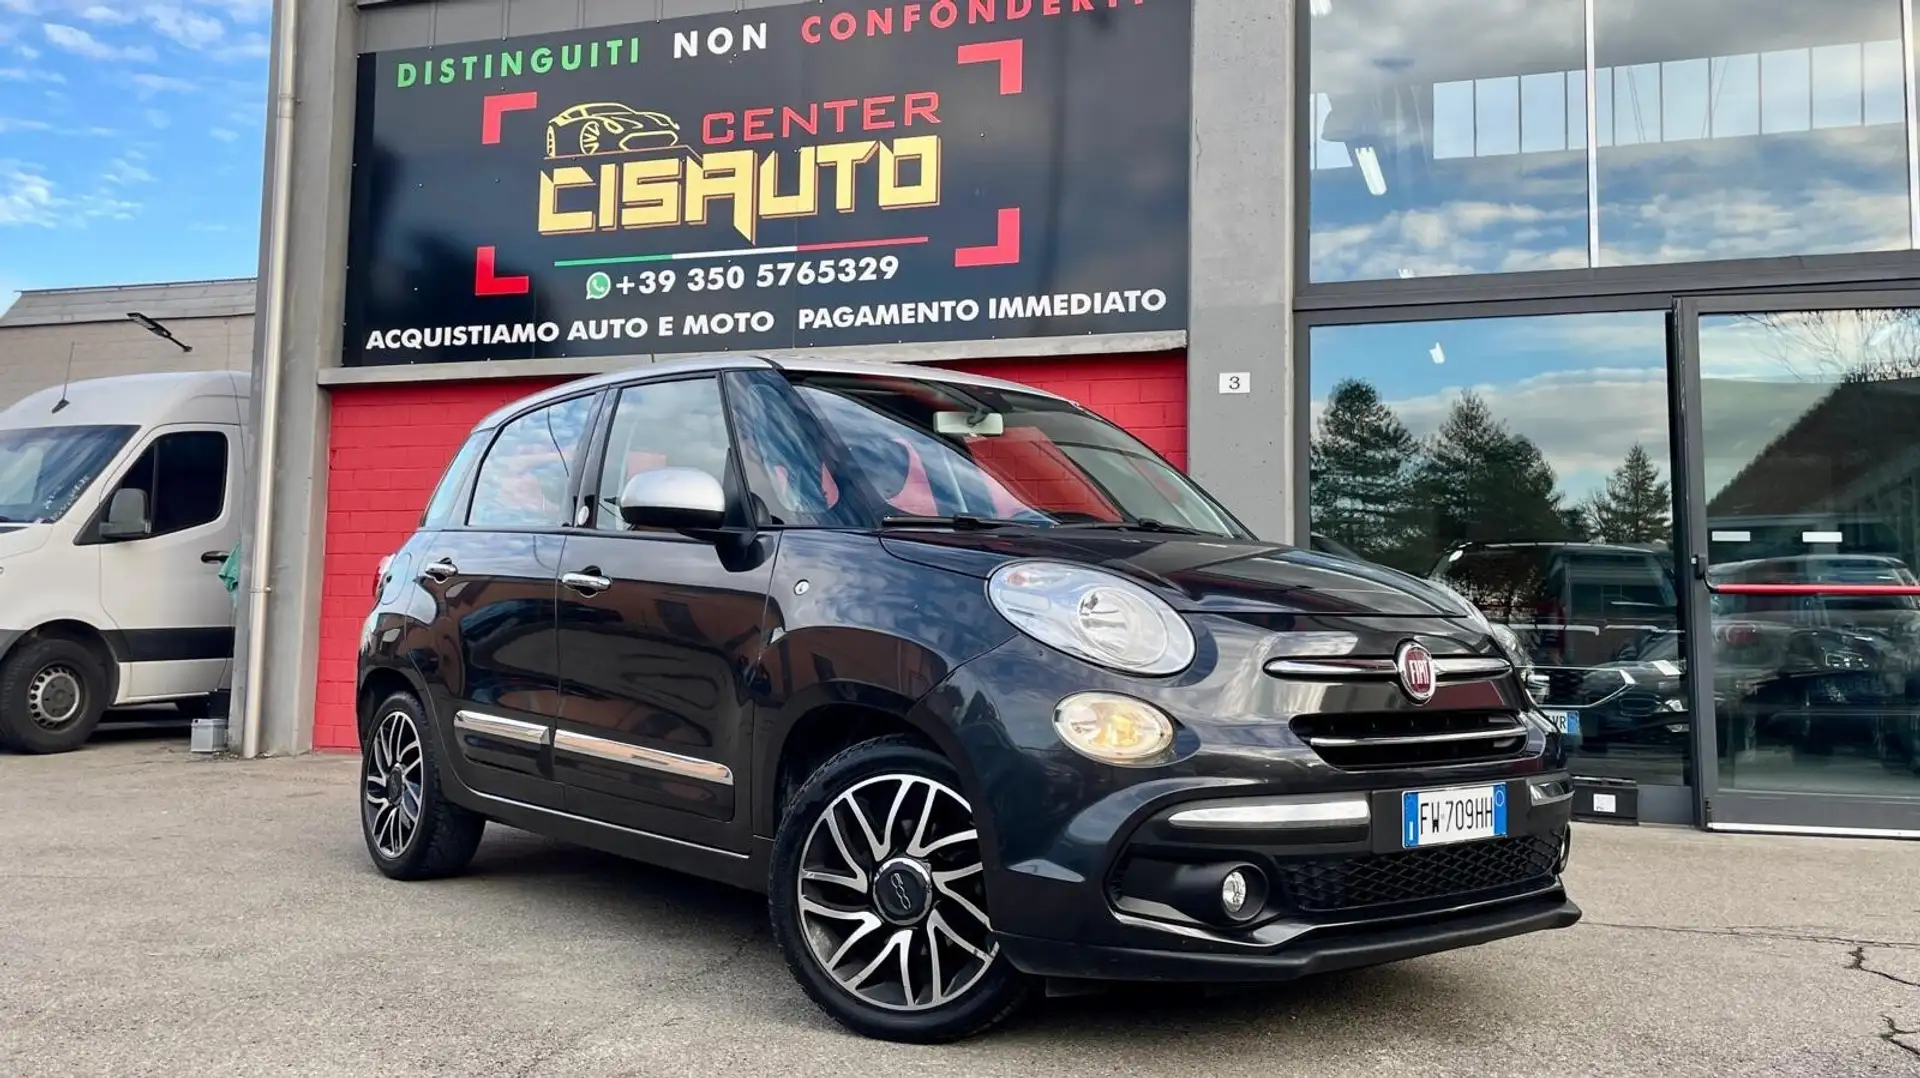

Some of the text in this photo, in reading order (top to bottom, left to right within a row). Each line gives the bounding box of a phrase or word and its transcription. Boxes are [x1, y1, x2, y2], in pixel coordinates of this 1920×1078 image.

[396, 0, 1143, 88] DISTINGUITI NON CONFONDE
[702, 91, 941, 145] CENTER
[538, 134, 941, 246] CISAUTO
[616, 255, 899, 295] +39 350 5765329
[366, 288, 1167, 349] ACQUISTIAMO AUTO E MOTO PAGAMENTO IMMEDIATO
[1229, 376, 1240, 390] 3
[1408, 659, 1430, 685] FIAT
